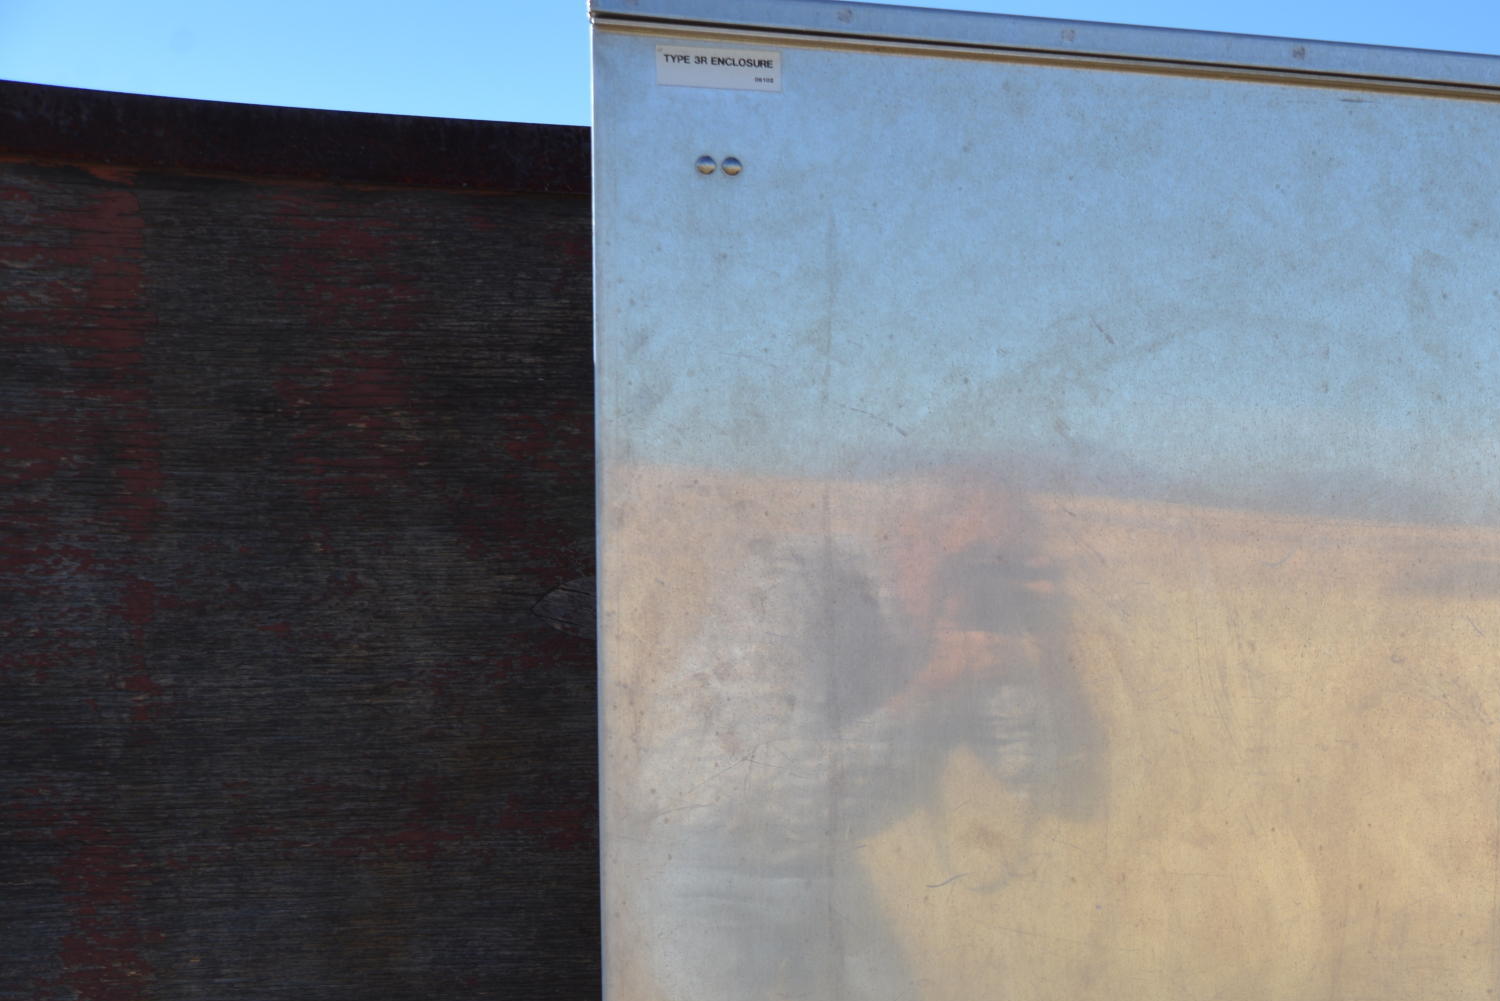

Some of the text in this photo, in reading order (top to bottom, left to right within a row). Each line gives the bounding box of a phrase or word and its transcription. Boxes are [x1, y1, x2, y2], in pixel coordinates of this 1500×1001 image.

[663, 53, 774, 69] TYPE 3R ENCLOSURE
